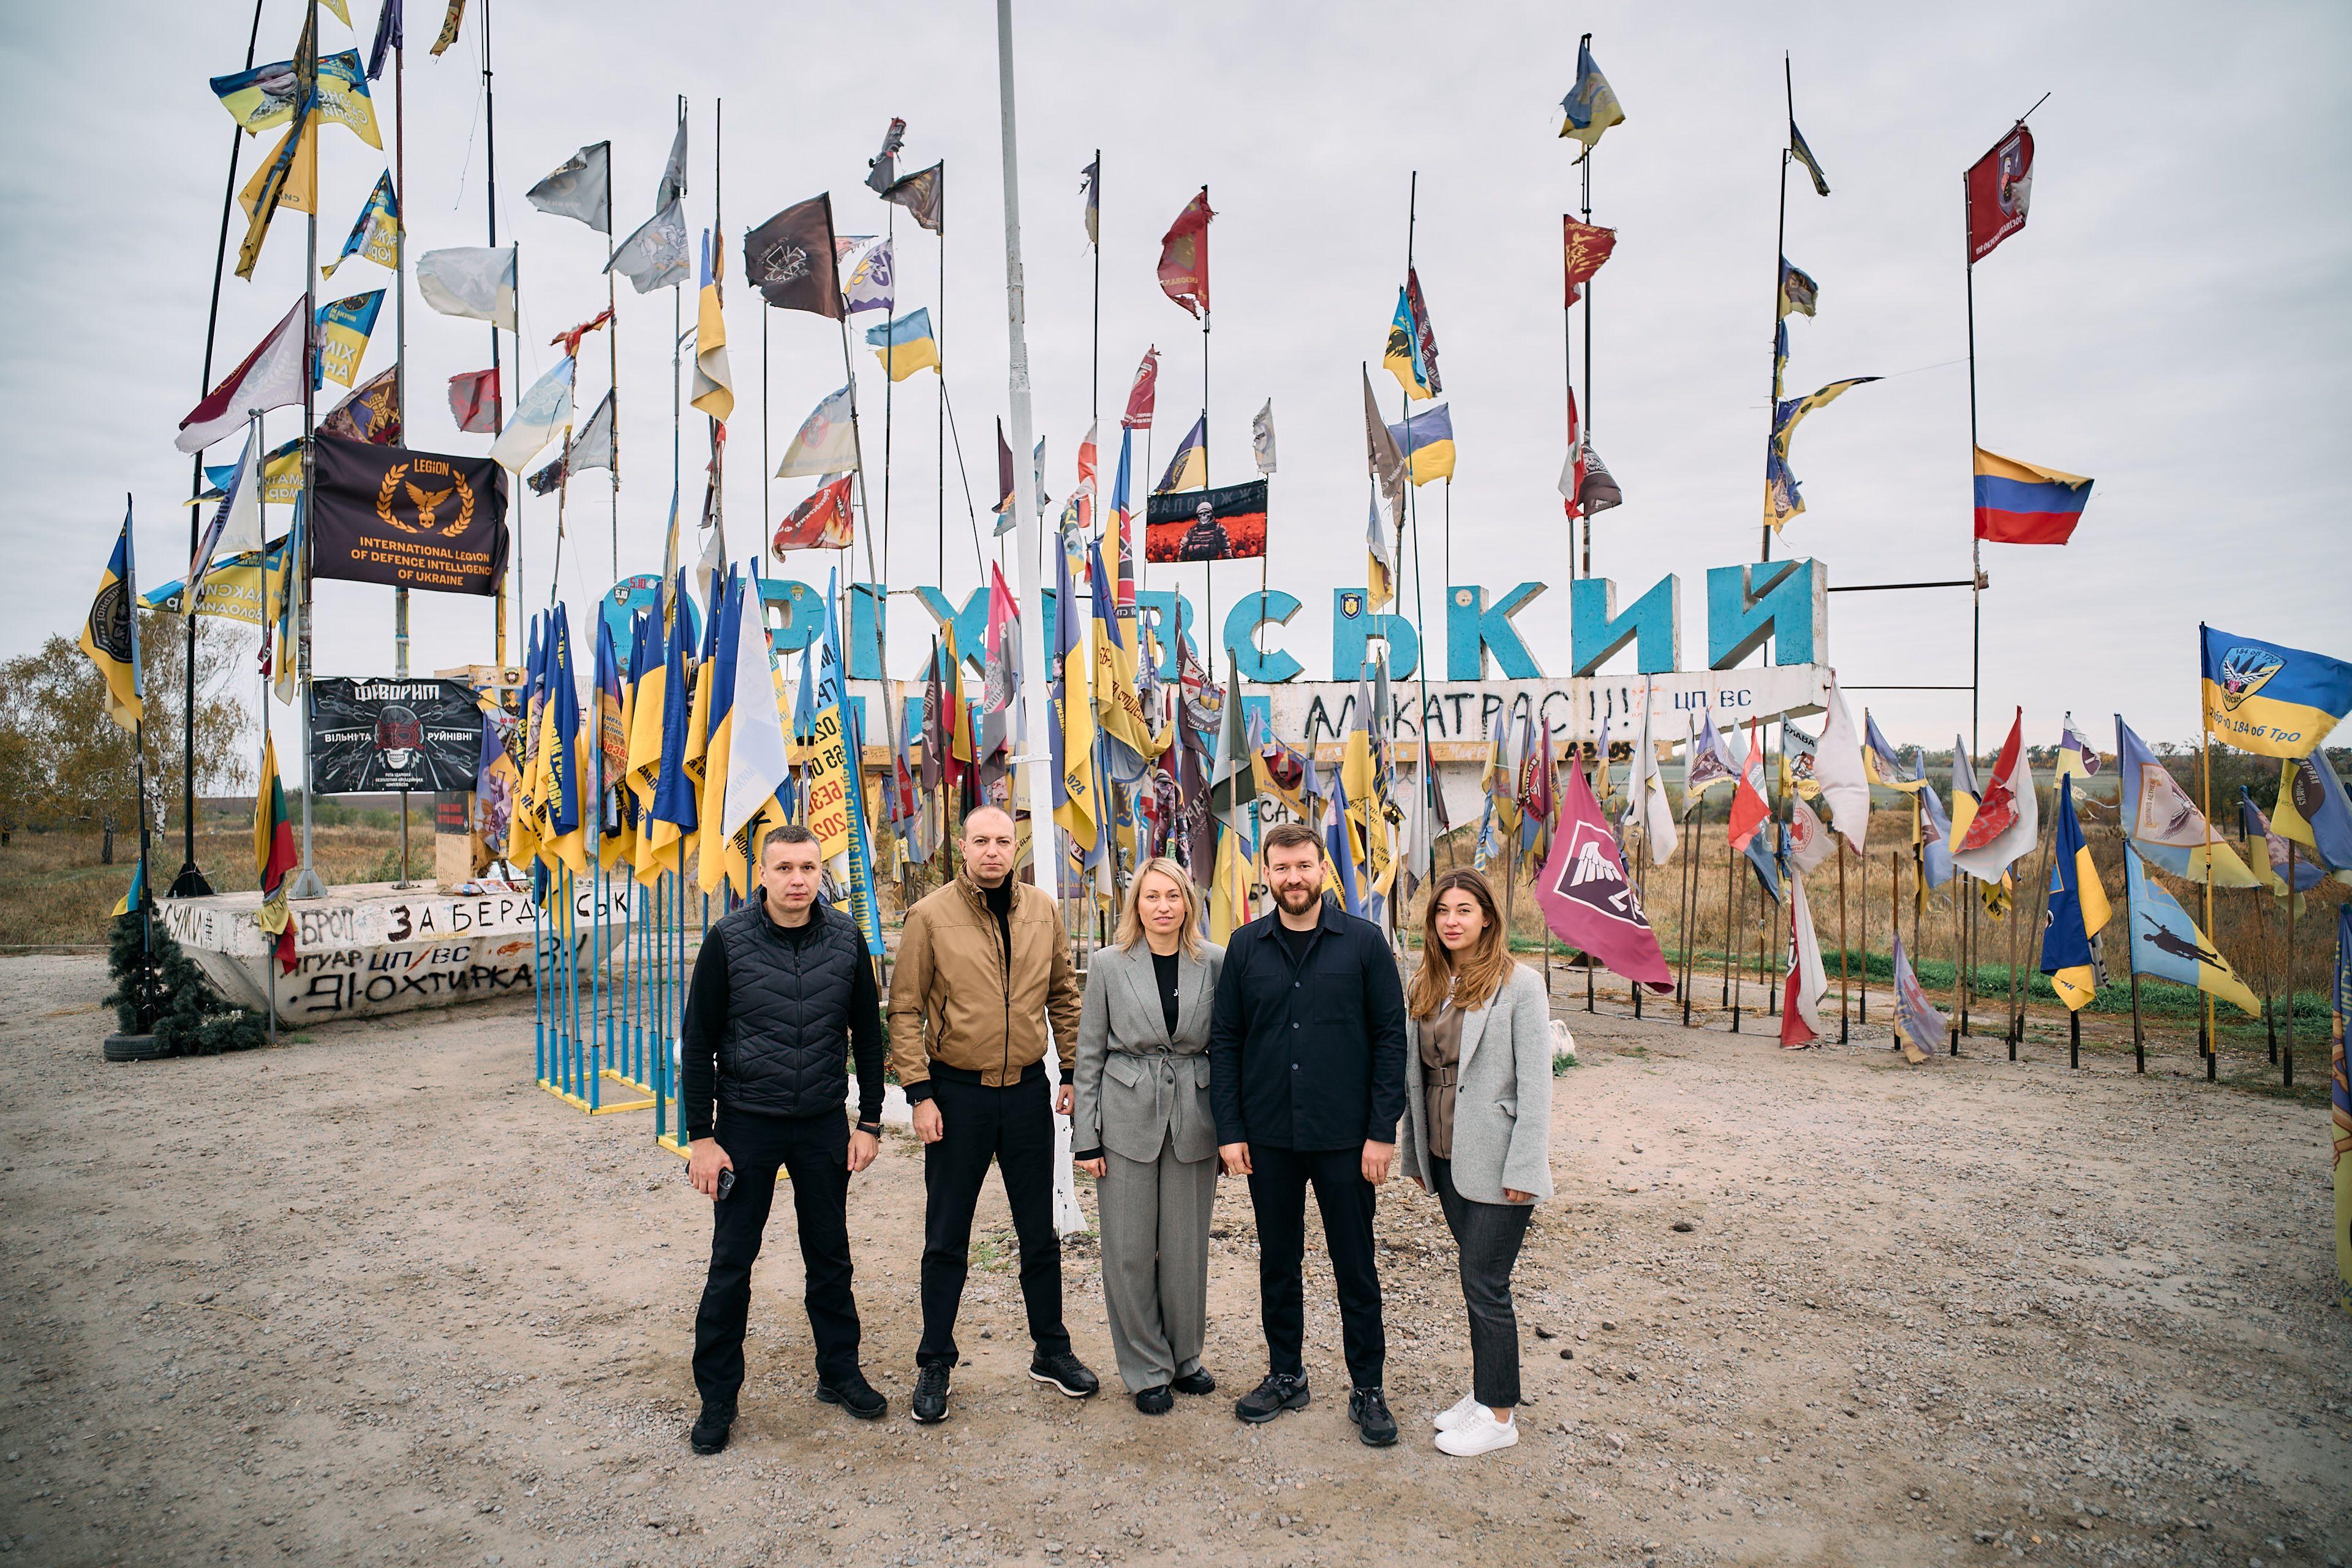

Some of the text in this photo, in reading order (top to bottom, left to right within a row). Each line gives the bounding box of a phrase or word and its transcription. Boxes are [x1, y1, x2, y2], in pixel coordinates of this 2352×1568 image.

[360, 536, 490, 563] INTERNATIONAL LEGION
[350, 549, 492, 576] OF DEFENCE INTELLIGENC
[398, 568, 464, 587] OF UKRAINE
[1675, 690, 1706, 711] ЦП
[1720, 689, 1752, 707] ВС
[325, 732, 472, 743] ВІЛЬНІ ТА РУЙНІВНІ
[1784, 723, 1815, 748] СЛАВА
